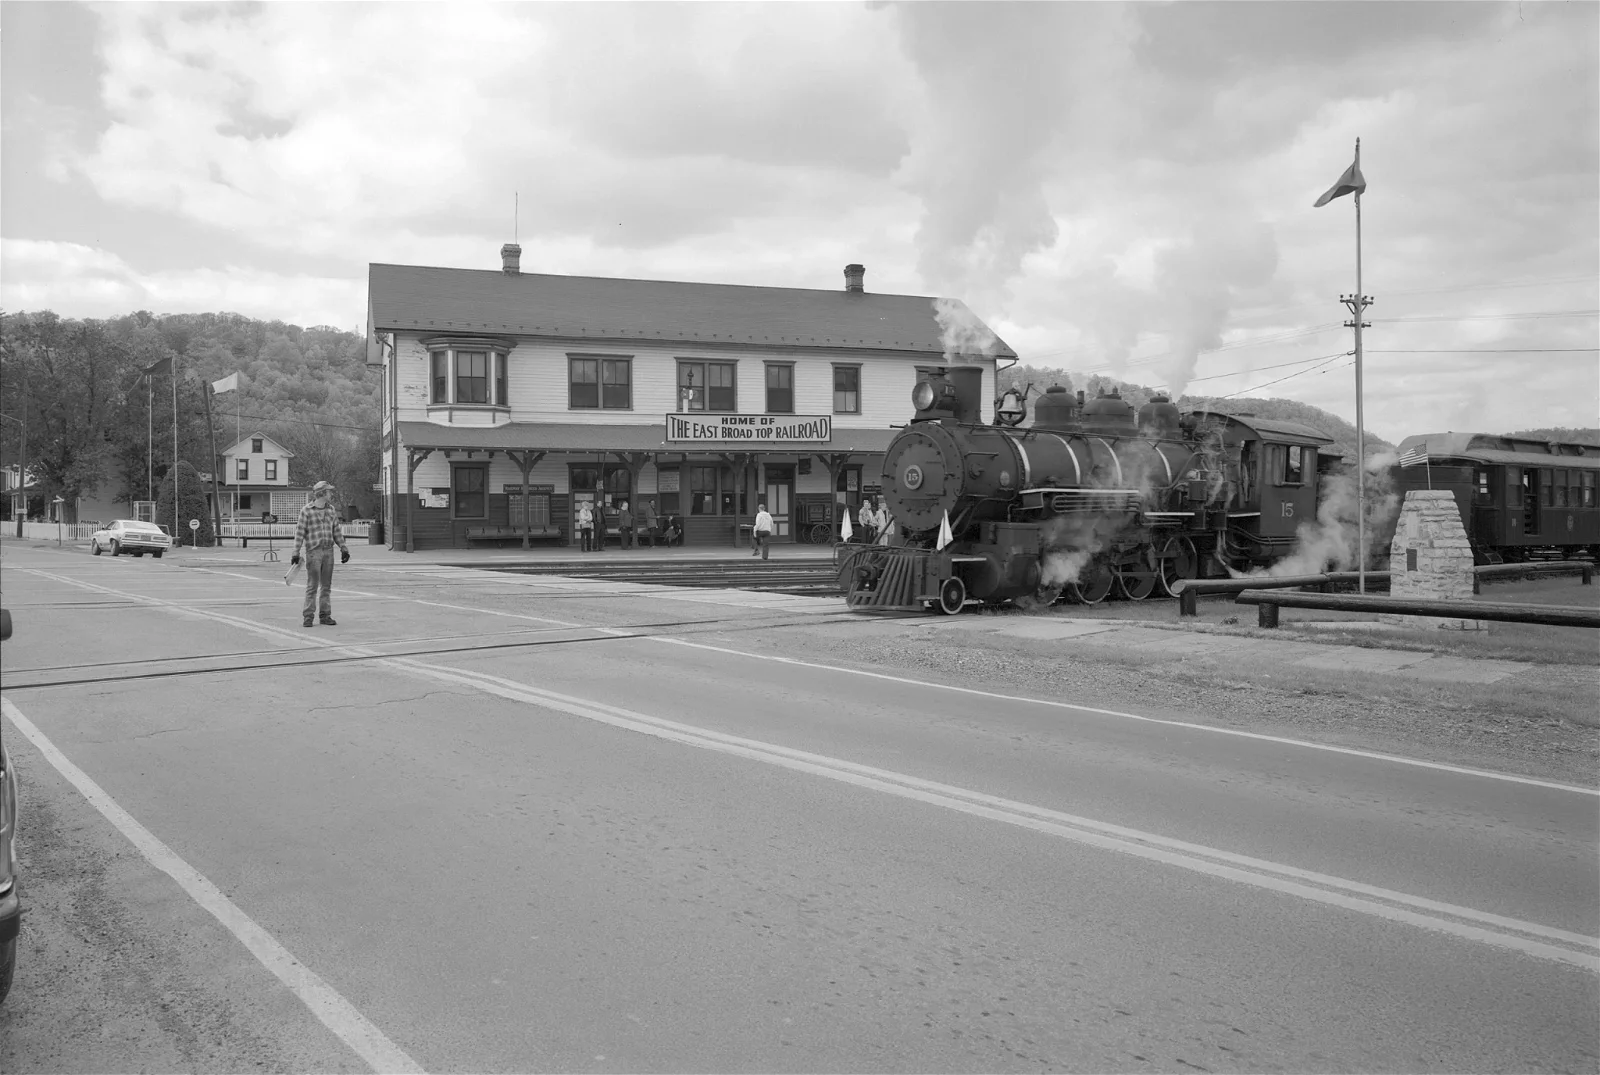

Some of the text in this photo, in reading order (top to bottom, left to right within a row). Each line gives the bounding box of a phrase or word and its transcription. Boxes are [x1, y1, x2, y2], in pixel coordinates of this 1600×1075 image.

[721, 417, 756, 425] HOME
[670, 416, 828, 439] THE EAST BROAD TOP RAILROAD
[908, 474, 918, 482] 15
[1282, 502, 1294, 517] 15
